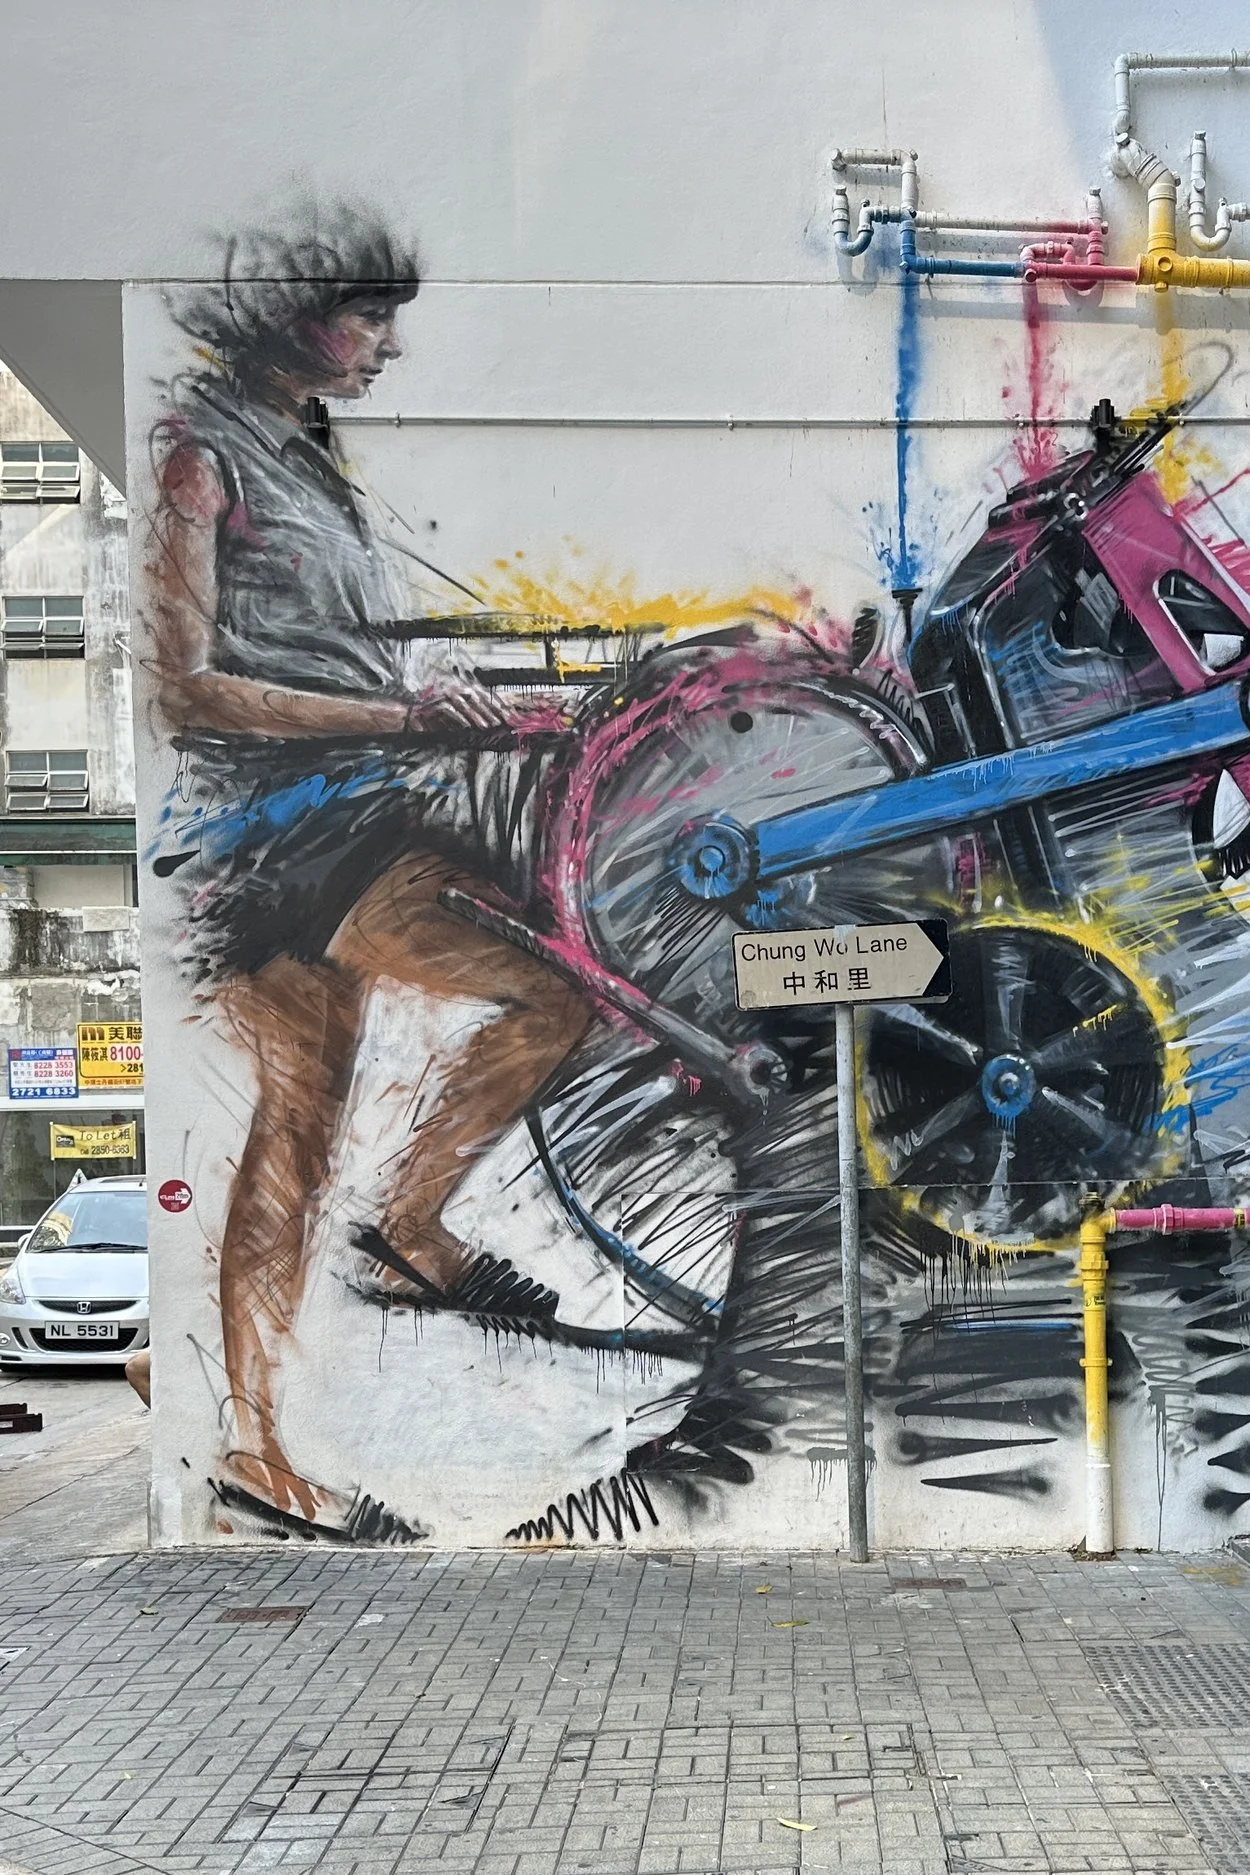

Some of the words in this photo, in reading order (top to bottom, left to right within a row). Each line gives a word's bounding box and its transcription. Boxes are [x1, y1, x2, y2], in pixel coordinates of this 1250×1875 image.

[741, 943, 806, 962] Chung
[814, 938, 848, 957] Wo
[856, 935, 908, 954] Lane
[783, 967, 872, 995] 中和里
[109, 1026, 143, 1040] 美聯
[12, 1088, 40, 1096] 2721
[46, 1087, 76, 1095] 6833
[80, 1131, 92, 1140] To
[97, 1130, 115, 1140] Let
[51, 1325, 72, 1337] NL
[77, 1325, 114, 1337] 5531
